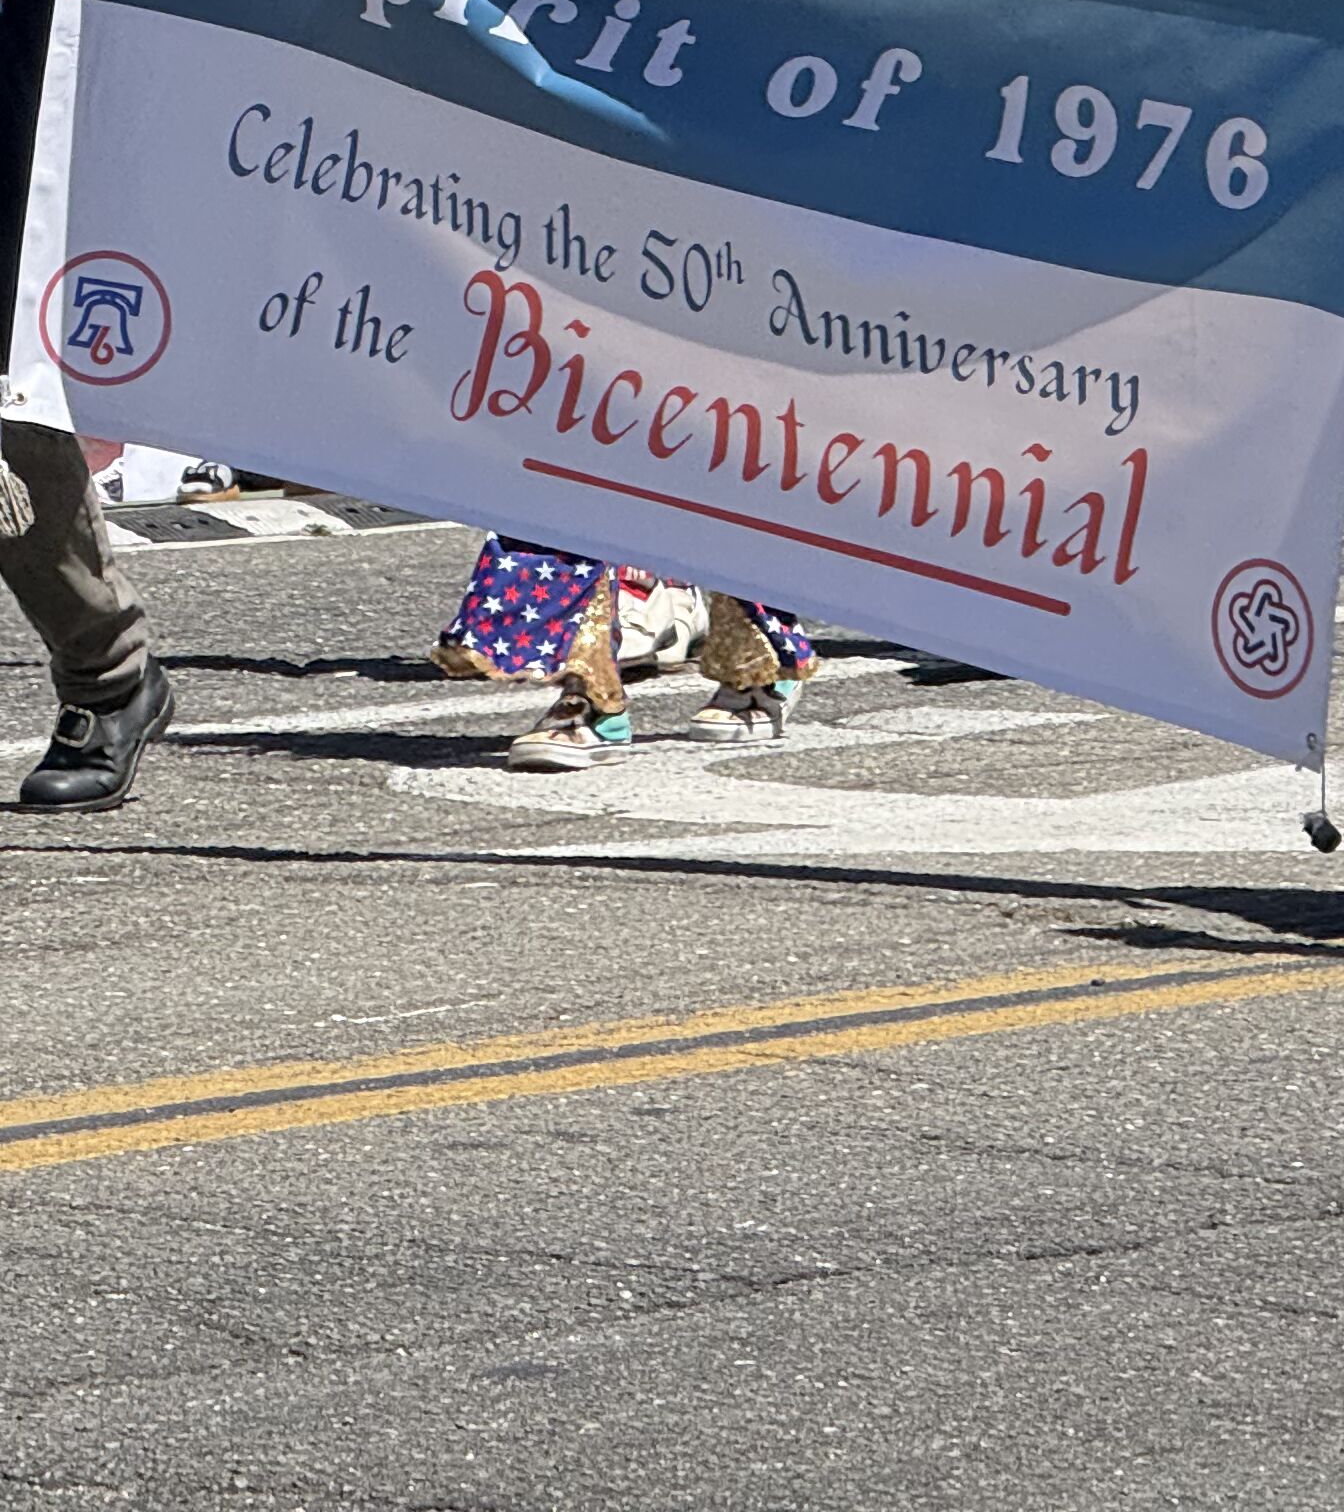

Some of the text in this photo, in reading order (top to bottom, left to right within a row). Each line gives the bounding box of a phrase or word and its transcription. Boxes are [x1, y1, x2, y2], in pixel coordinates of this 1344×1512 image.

[228, 103, 1141, 437] Celebrating the 50th Anniversary
[767, 47, 923, 131] of
[985, 75, 1269, 210] 1976
[258, 270, 1147, 585] of the Bicentennial
